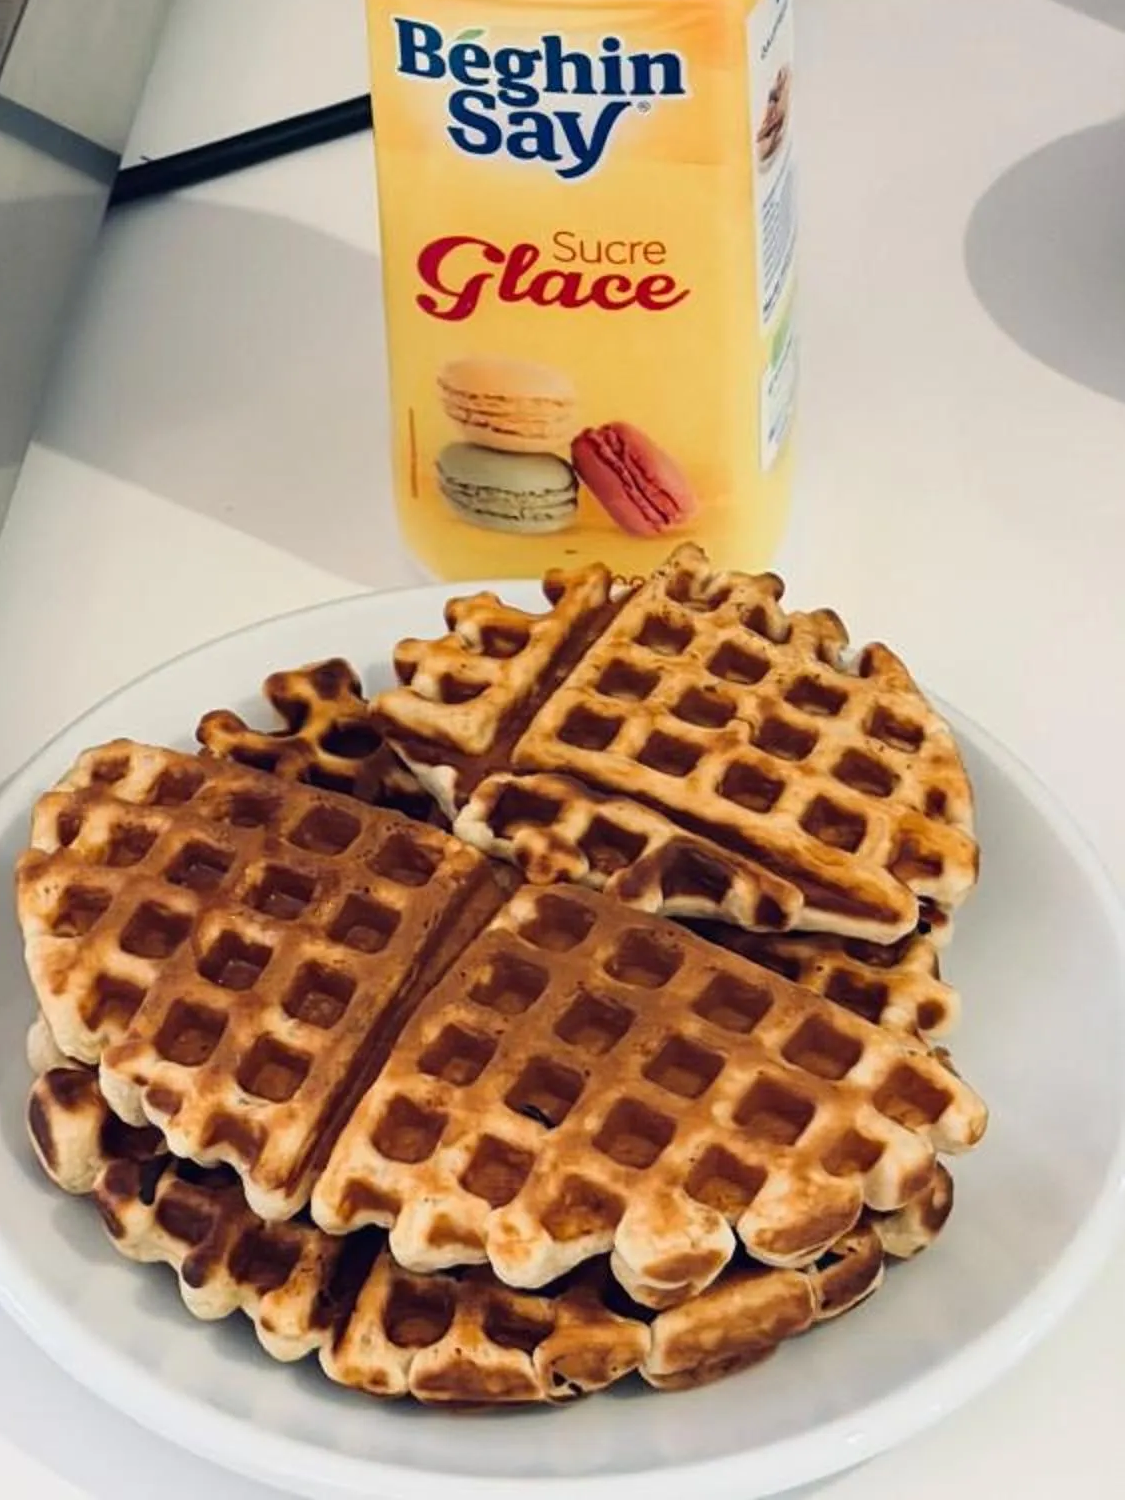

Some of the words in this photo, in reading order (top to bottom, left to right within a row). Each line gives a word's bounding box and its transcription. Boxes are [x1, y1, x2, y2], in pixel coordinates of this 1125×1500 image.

[394, 17, 686, 108] Béghin
[447, 89, 632, 179] Say
[416, 235, 691, 322] Glace
[552, 231, 667, 265] Sucre
